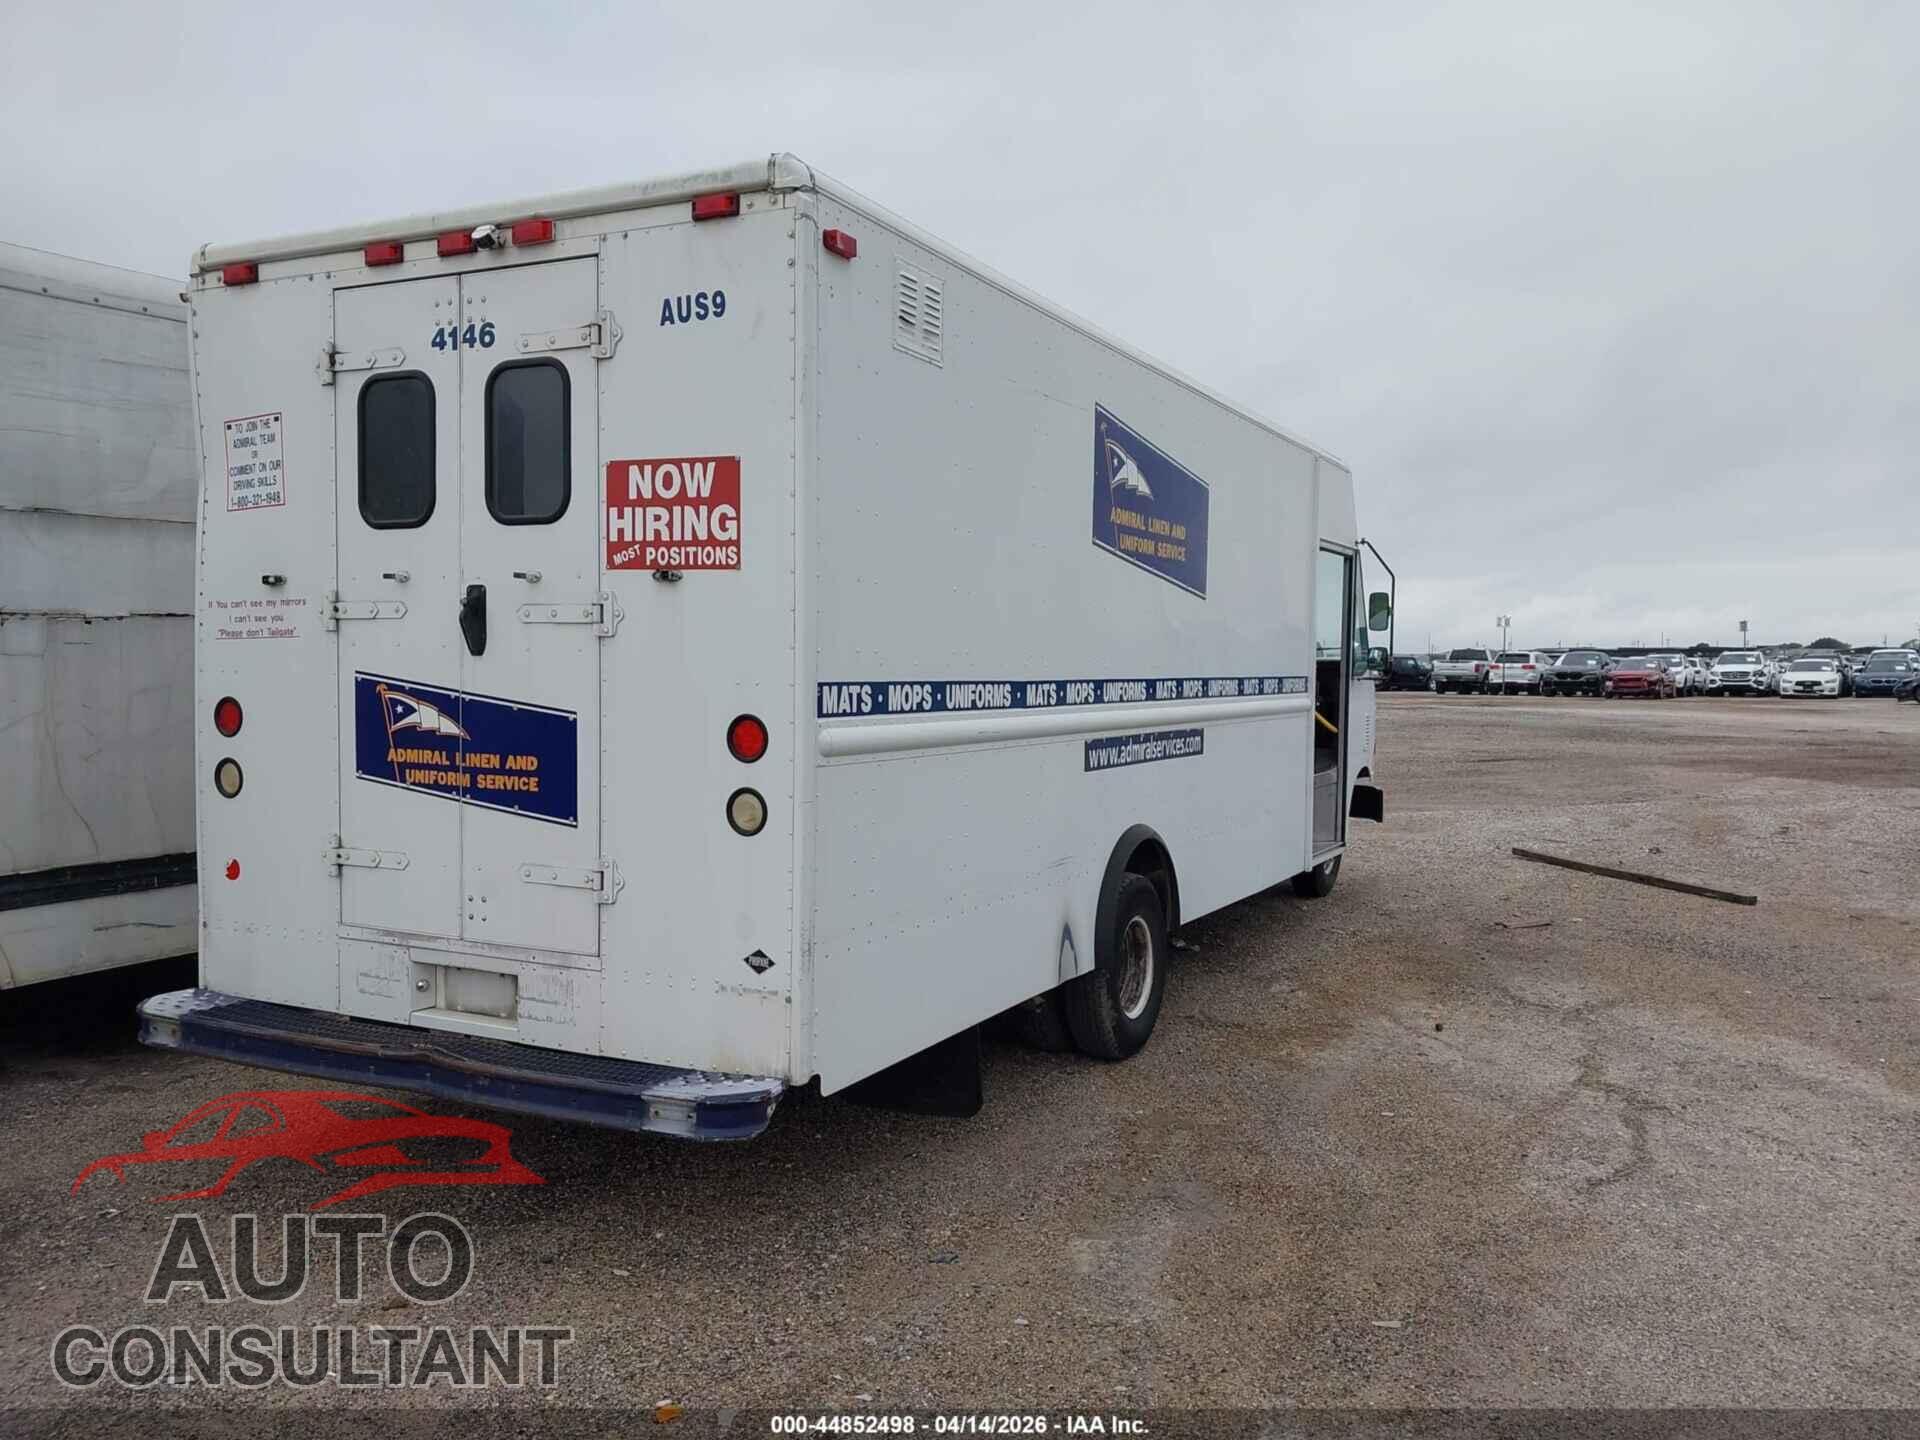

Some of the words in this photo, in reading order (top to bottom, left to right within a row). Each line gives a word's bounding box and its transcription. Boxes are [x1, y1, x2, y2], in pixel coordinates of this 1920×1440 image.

[660, 290, 726, 326] AUS9
[431, 322, 496, 351] 4146
[235, 423, 242, 433] TO
[245, 420, 257, 432] JOIN
[259, 418, 270, 430] THE
[233, 438, 257, 449] ADMIRAL
[259, 432, 276, 445] TEAM
[229, 463, 256, 477] COMMENT
[258, 462, 267, 473] ON
[269, 460, 281, 472] OUR
[233, 478, 256, 491] DRIVING
[257, 475, 277, 488] SKILLS
[628, 462, 716, 500] NOW
[609, 504, 738, 542] HIRING
[1110, 506, 1146, 530] ADMIRAL
[1148, 516, 1170, 537] LINEN
[1171, 521, 1186, 540] AND
[612, 544, 641, 566] MOST
[646, 546, 738, 565] POSITIONS
[1119, 533, 1155, 554] UNIFORM
[1157, 542, 1186, 562] SERVICE
[230, 600, 247, 608] can't
[250, 600, 263, 608] see
[265, 600, 277, 609] my
[280, 598, 306, 609] mirrors
[234, 615, 251, 624] can't
[270, 615, 284, 624] you
[822, 685, 873, 714] MATS
[888, 684, 932, 711] MOPS
[945, 683, 1012, 709] UNIFORMS
[1026, 682, 1057, 706] MATS
[1066, 682, 1095, 704] MOPS
[1103, 681, 1147, 702] UNIFORMS
[1155, 680, 1178, 699] MATS
[1183, 680, 1203, 698] MOPS
[1207, 679, 1239, 696] UNIFORMS
[387, 748, 450, 766] ADMIRAL
[455, 752, 500, 769] LINEN
[505, 754, 539, 771] AND
[1088, 734, 1201, 768] www.admiralservices.com
[405, 769, 470, 787] UNIFORM
[476, 774, 540, 792] SERVICE
